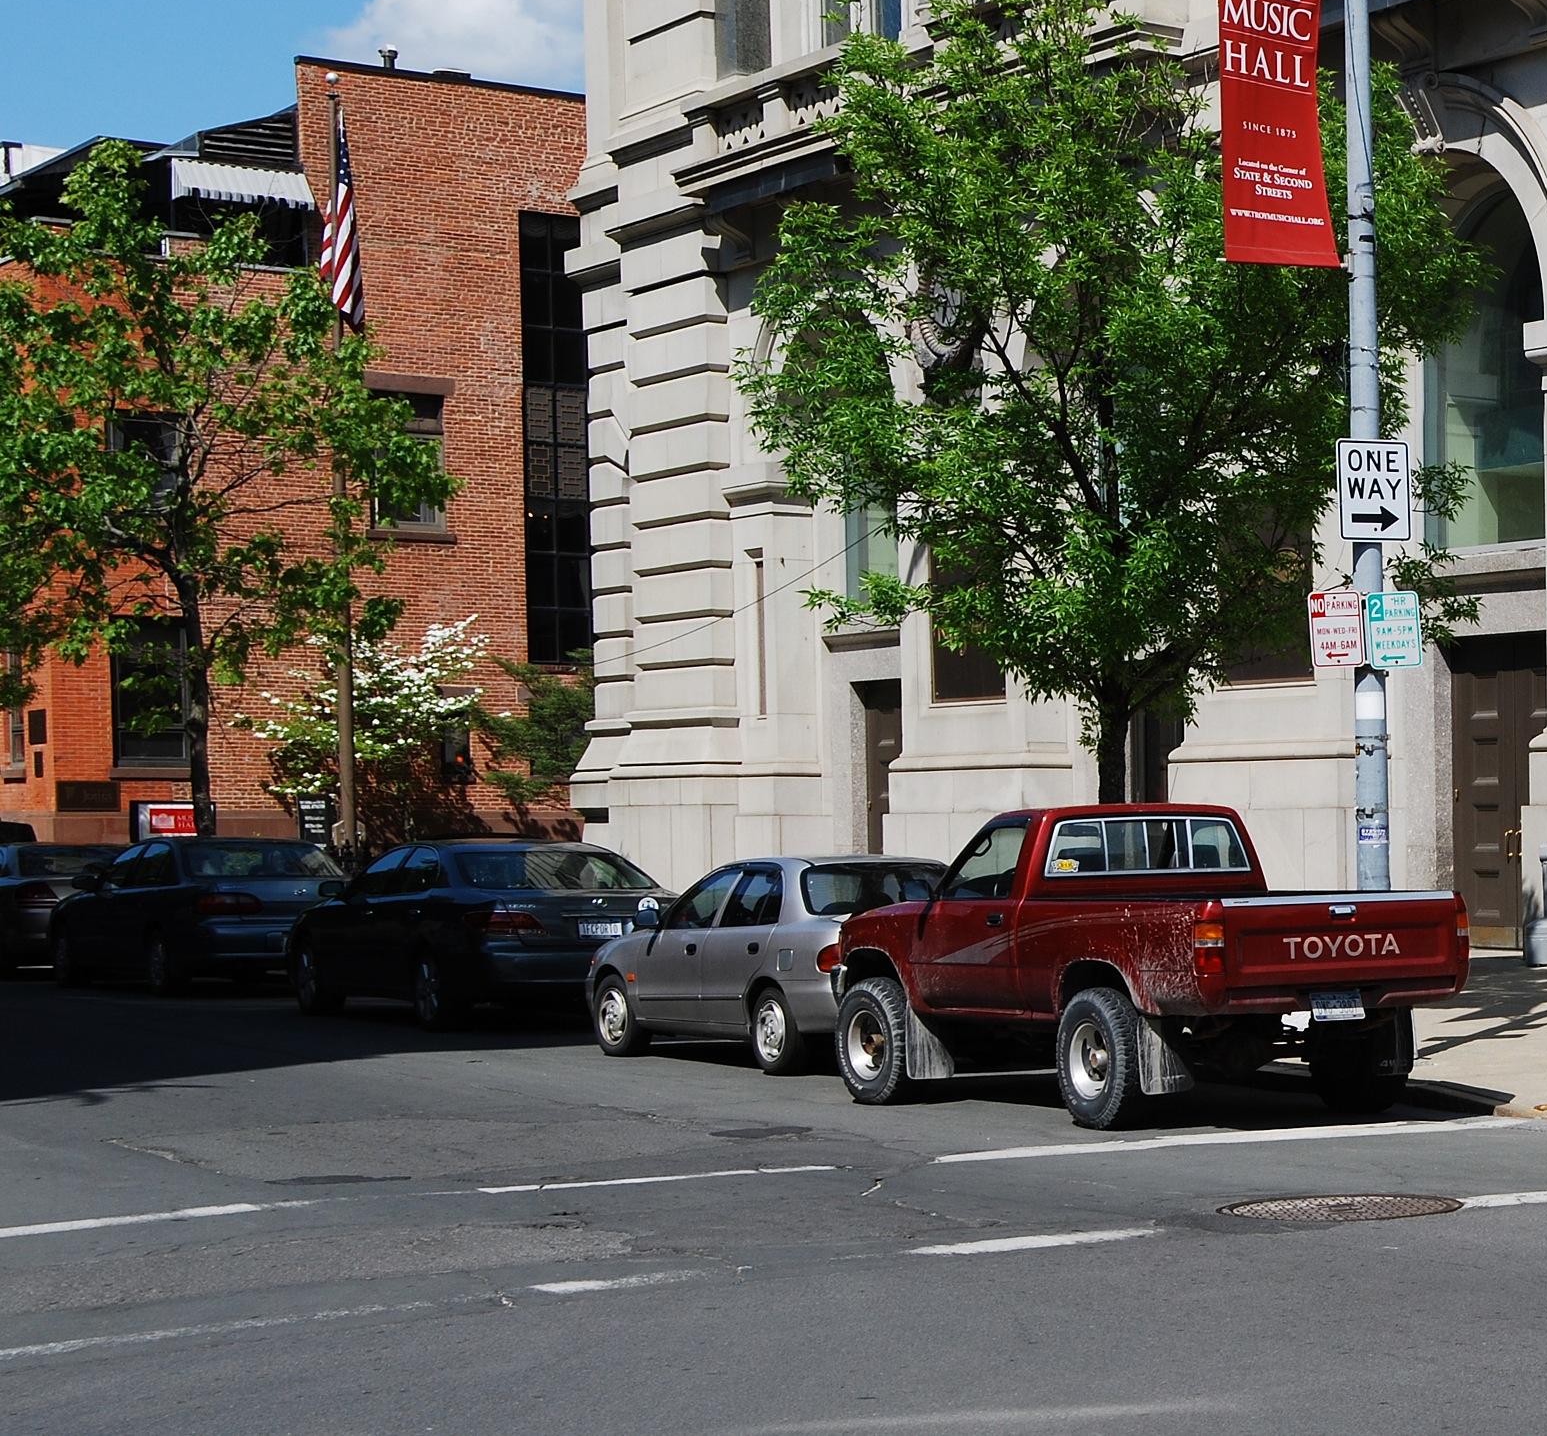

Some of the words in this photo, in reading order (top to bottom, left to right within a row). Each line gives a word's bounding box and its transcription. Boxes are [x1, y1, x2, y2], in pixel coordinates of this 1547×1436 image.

[1223, 39, 1310, 88] HALL
[1242, 120, 1271, 134] SINCE
[1276, 127, 1297, 139] 1875
[1233, 167, 1261, 182] STATE
[1263, 172, 1272, 184] &
[1273, 173, 1313, 189] SECOND
[1255, 184, 1293, 200] STREETS
[1347, 449, 1399, 473] ONE
[1347, 477, 1402, 500] WAY
[1311, 598, 1325, 613] NO
[1326, 599, 1358, 610] PARKING
[1370, 598, 1382, 618] 2
[1393, 596, 1406, 606] HR
[1385, 608, 1415, 618] PARKING
[1375, 639, 1416, 650] WEEKDAYS
[1283, 933, 1400, 960] TOYOTA
